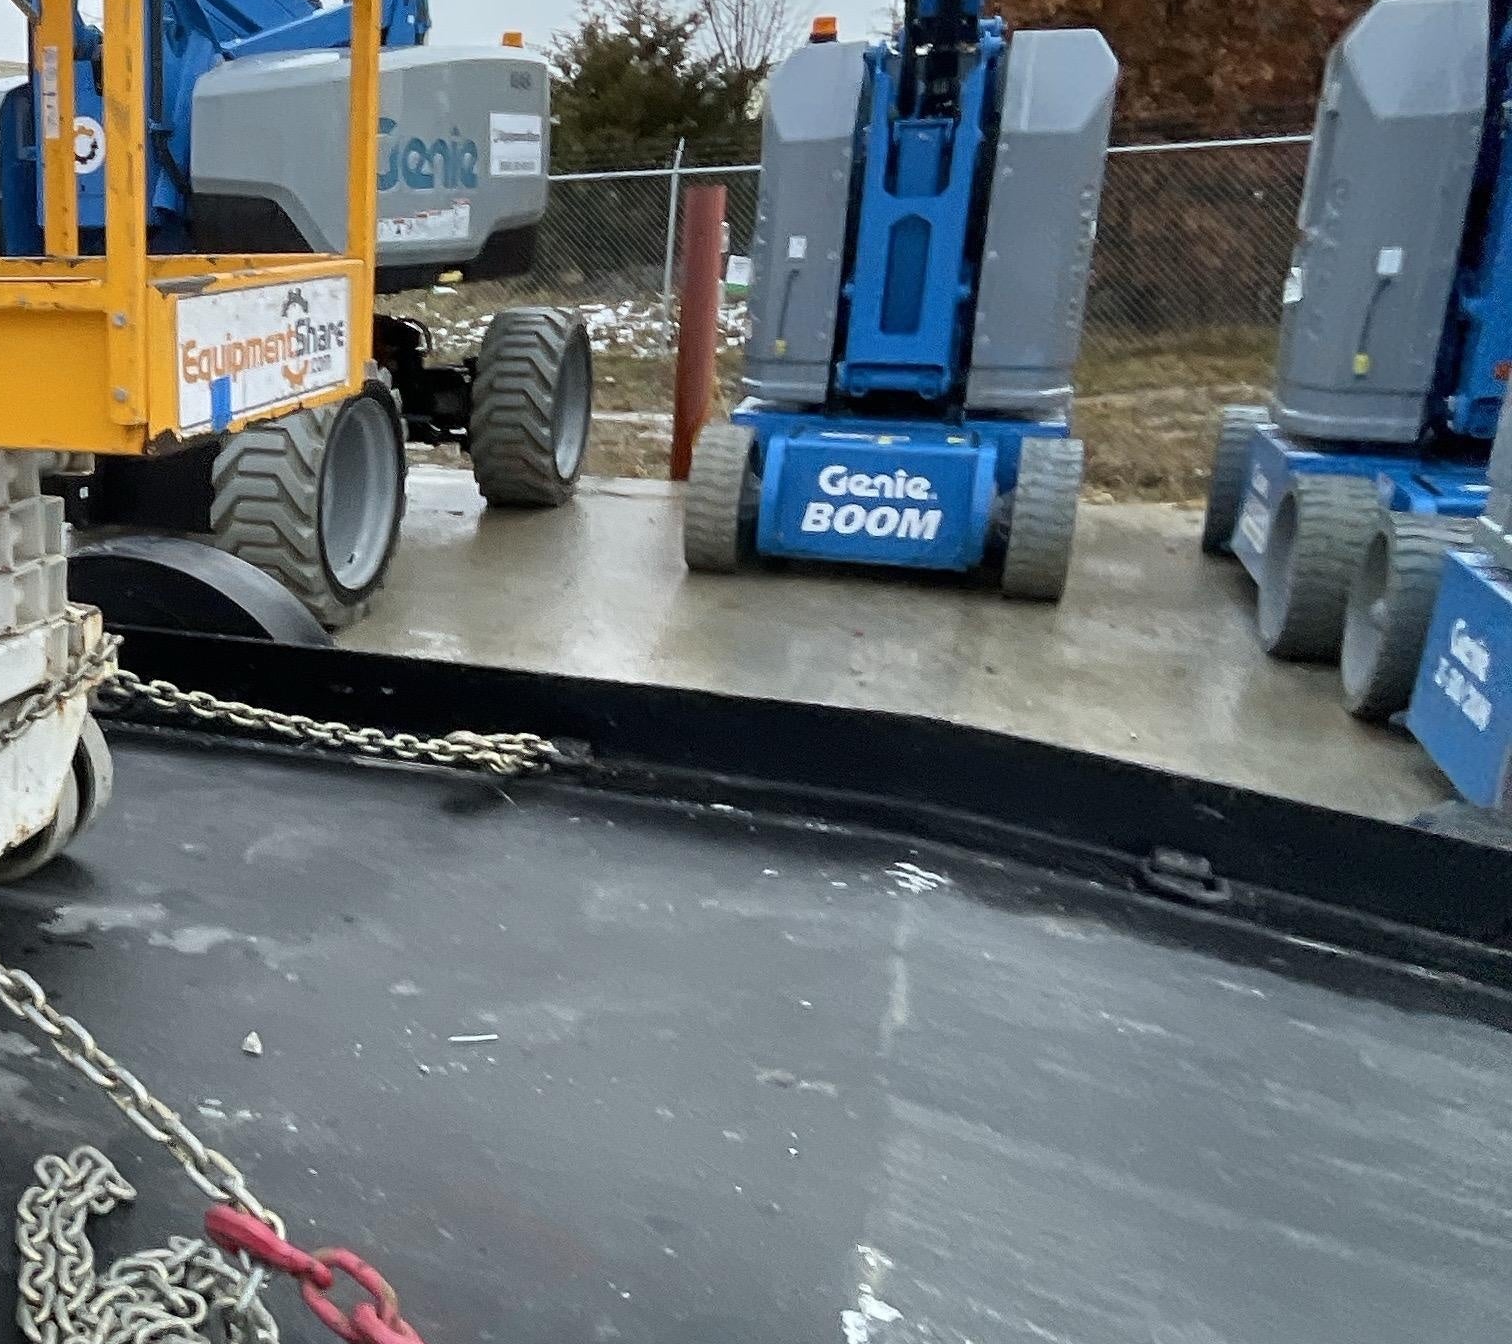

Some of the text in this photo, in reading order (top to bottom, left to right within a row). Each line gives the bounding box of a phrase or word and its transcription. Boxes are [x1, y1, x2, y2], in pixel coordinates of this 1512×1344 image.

[183, 317, 344, 383] EquipmentShare
[818, 465, 932, 500] Genie
[801, 501, 943, 540] BOOM
